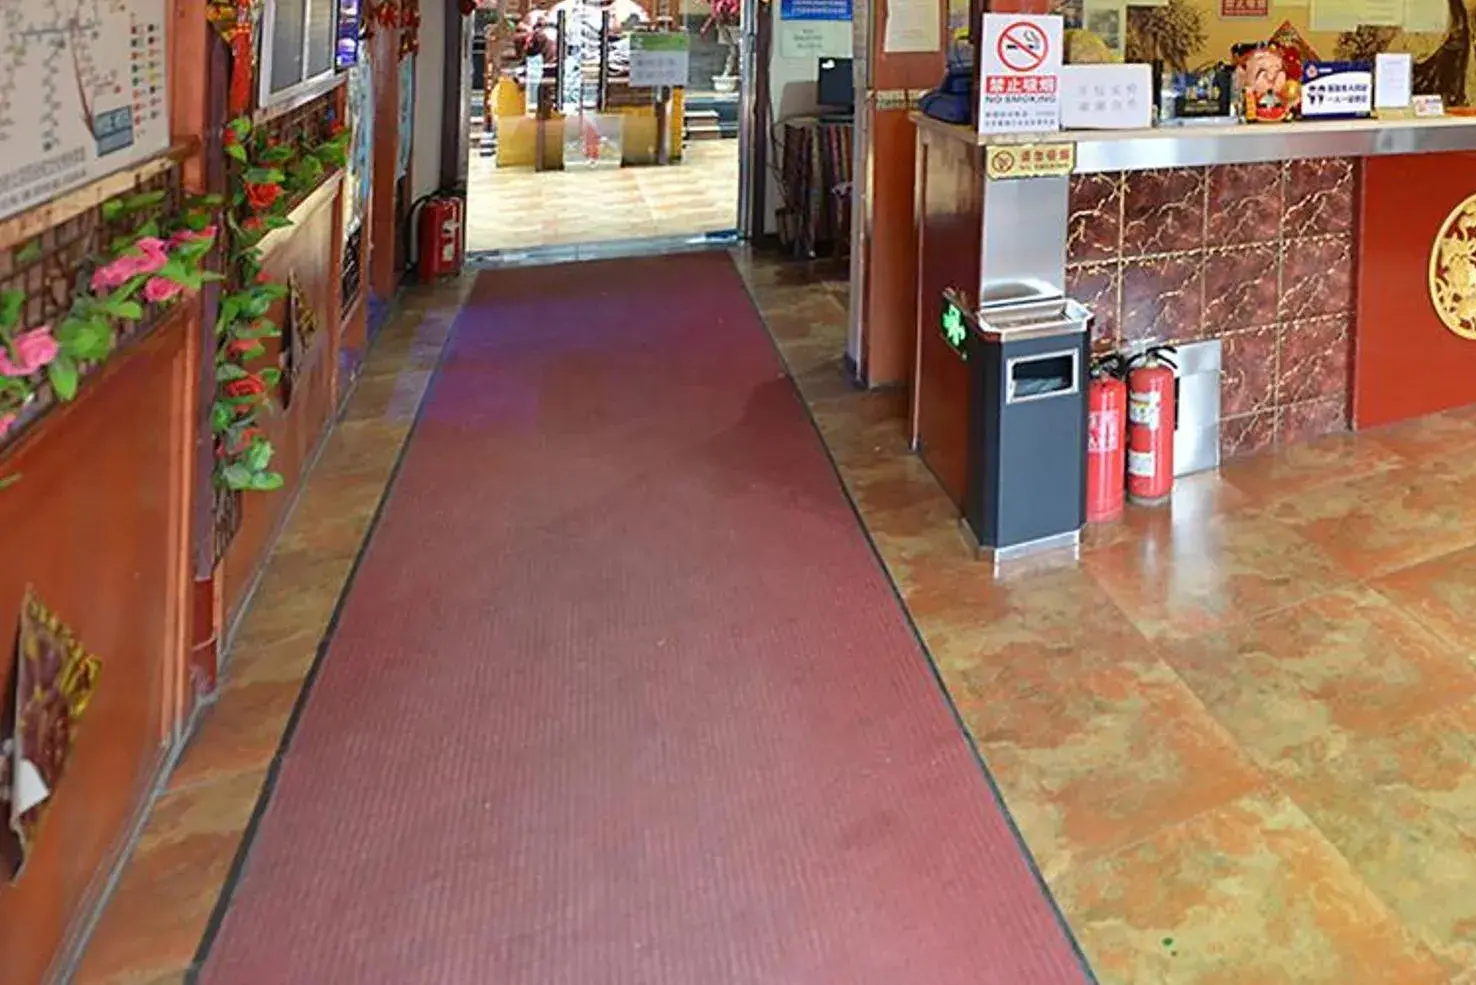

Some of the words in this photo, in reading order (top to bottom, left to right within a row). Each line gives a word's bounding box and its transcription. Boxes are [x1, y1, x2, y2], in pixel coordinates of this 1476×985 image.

[989, 77, 1055, 92] 禁止吸烟
[1005, 95, 1056, 103] SMOKING
